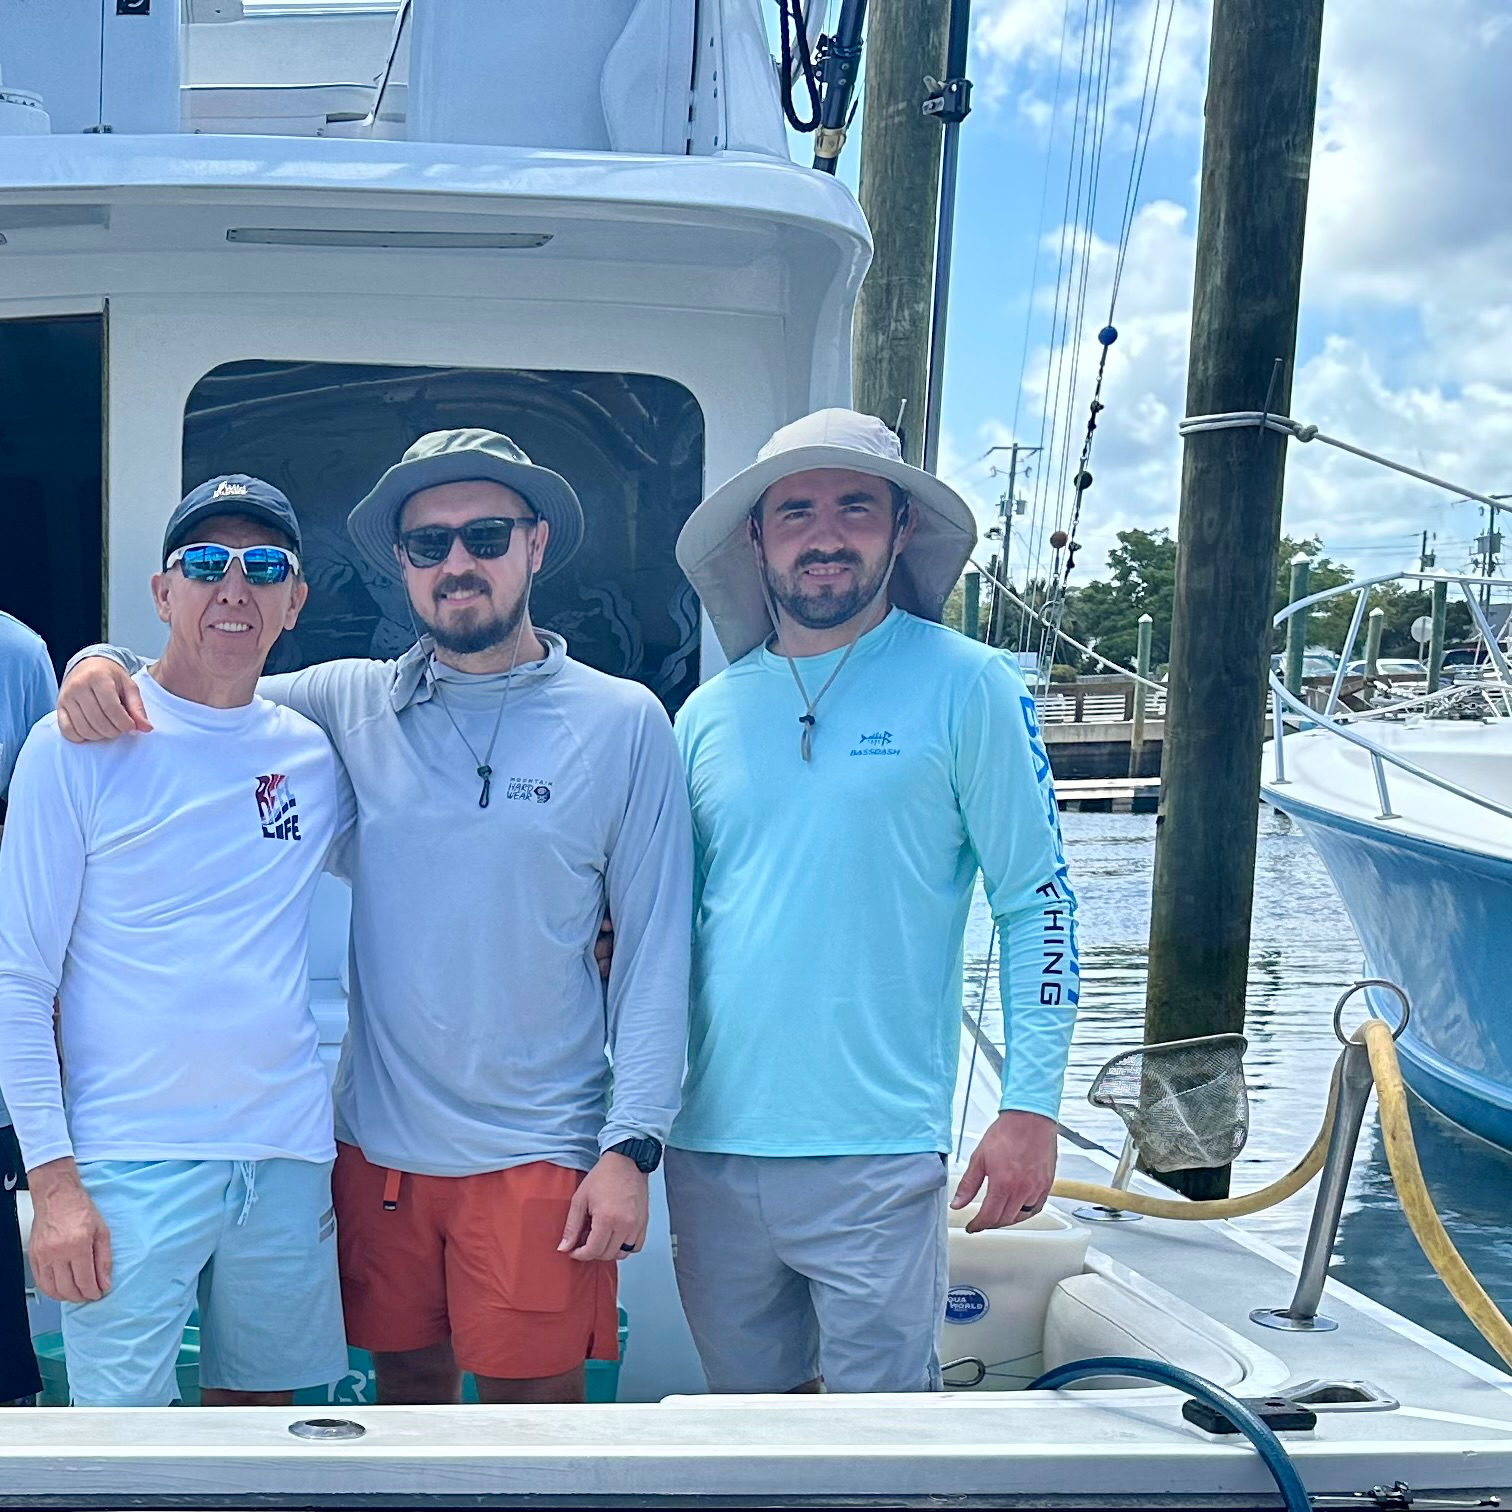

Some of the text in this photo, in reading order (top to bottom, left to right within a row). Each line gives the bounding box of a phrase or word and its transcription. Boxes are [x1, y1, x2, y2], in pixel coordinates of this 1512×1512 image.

[510, 777, 553, 786] MOUNTAIN
[508, 783, 534, 792] HARD
[262, 815, 301, 840] LIFE
